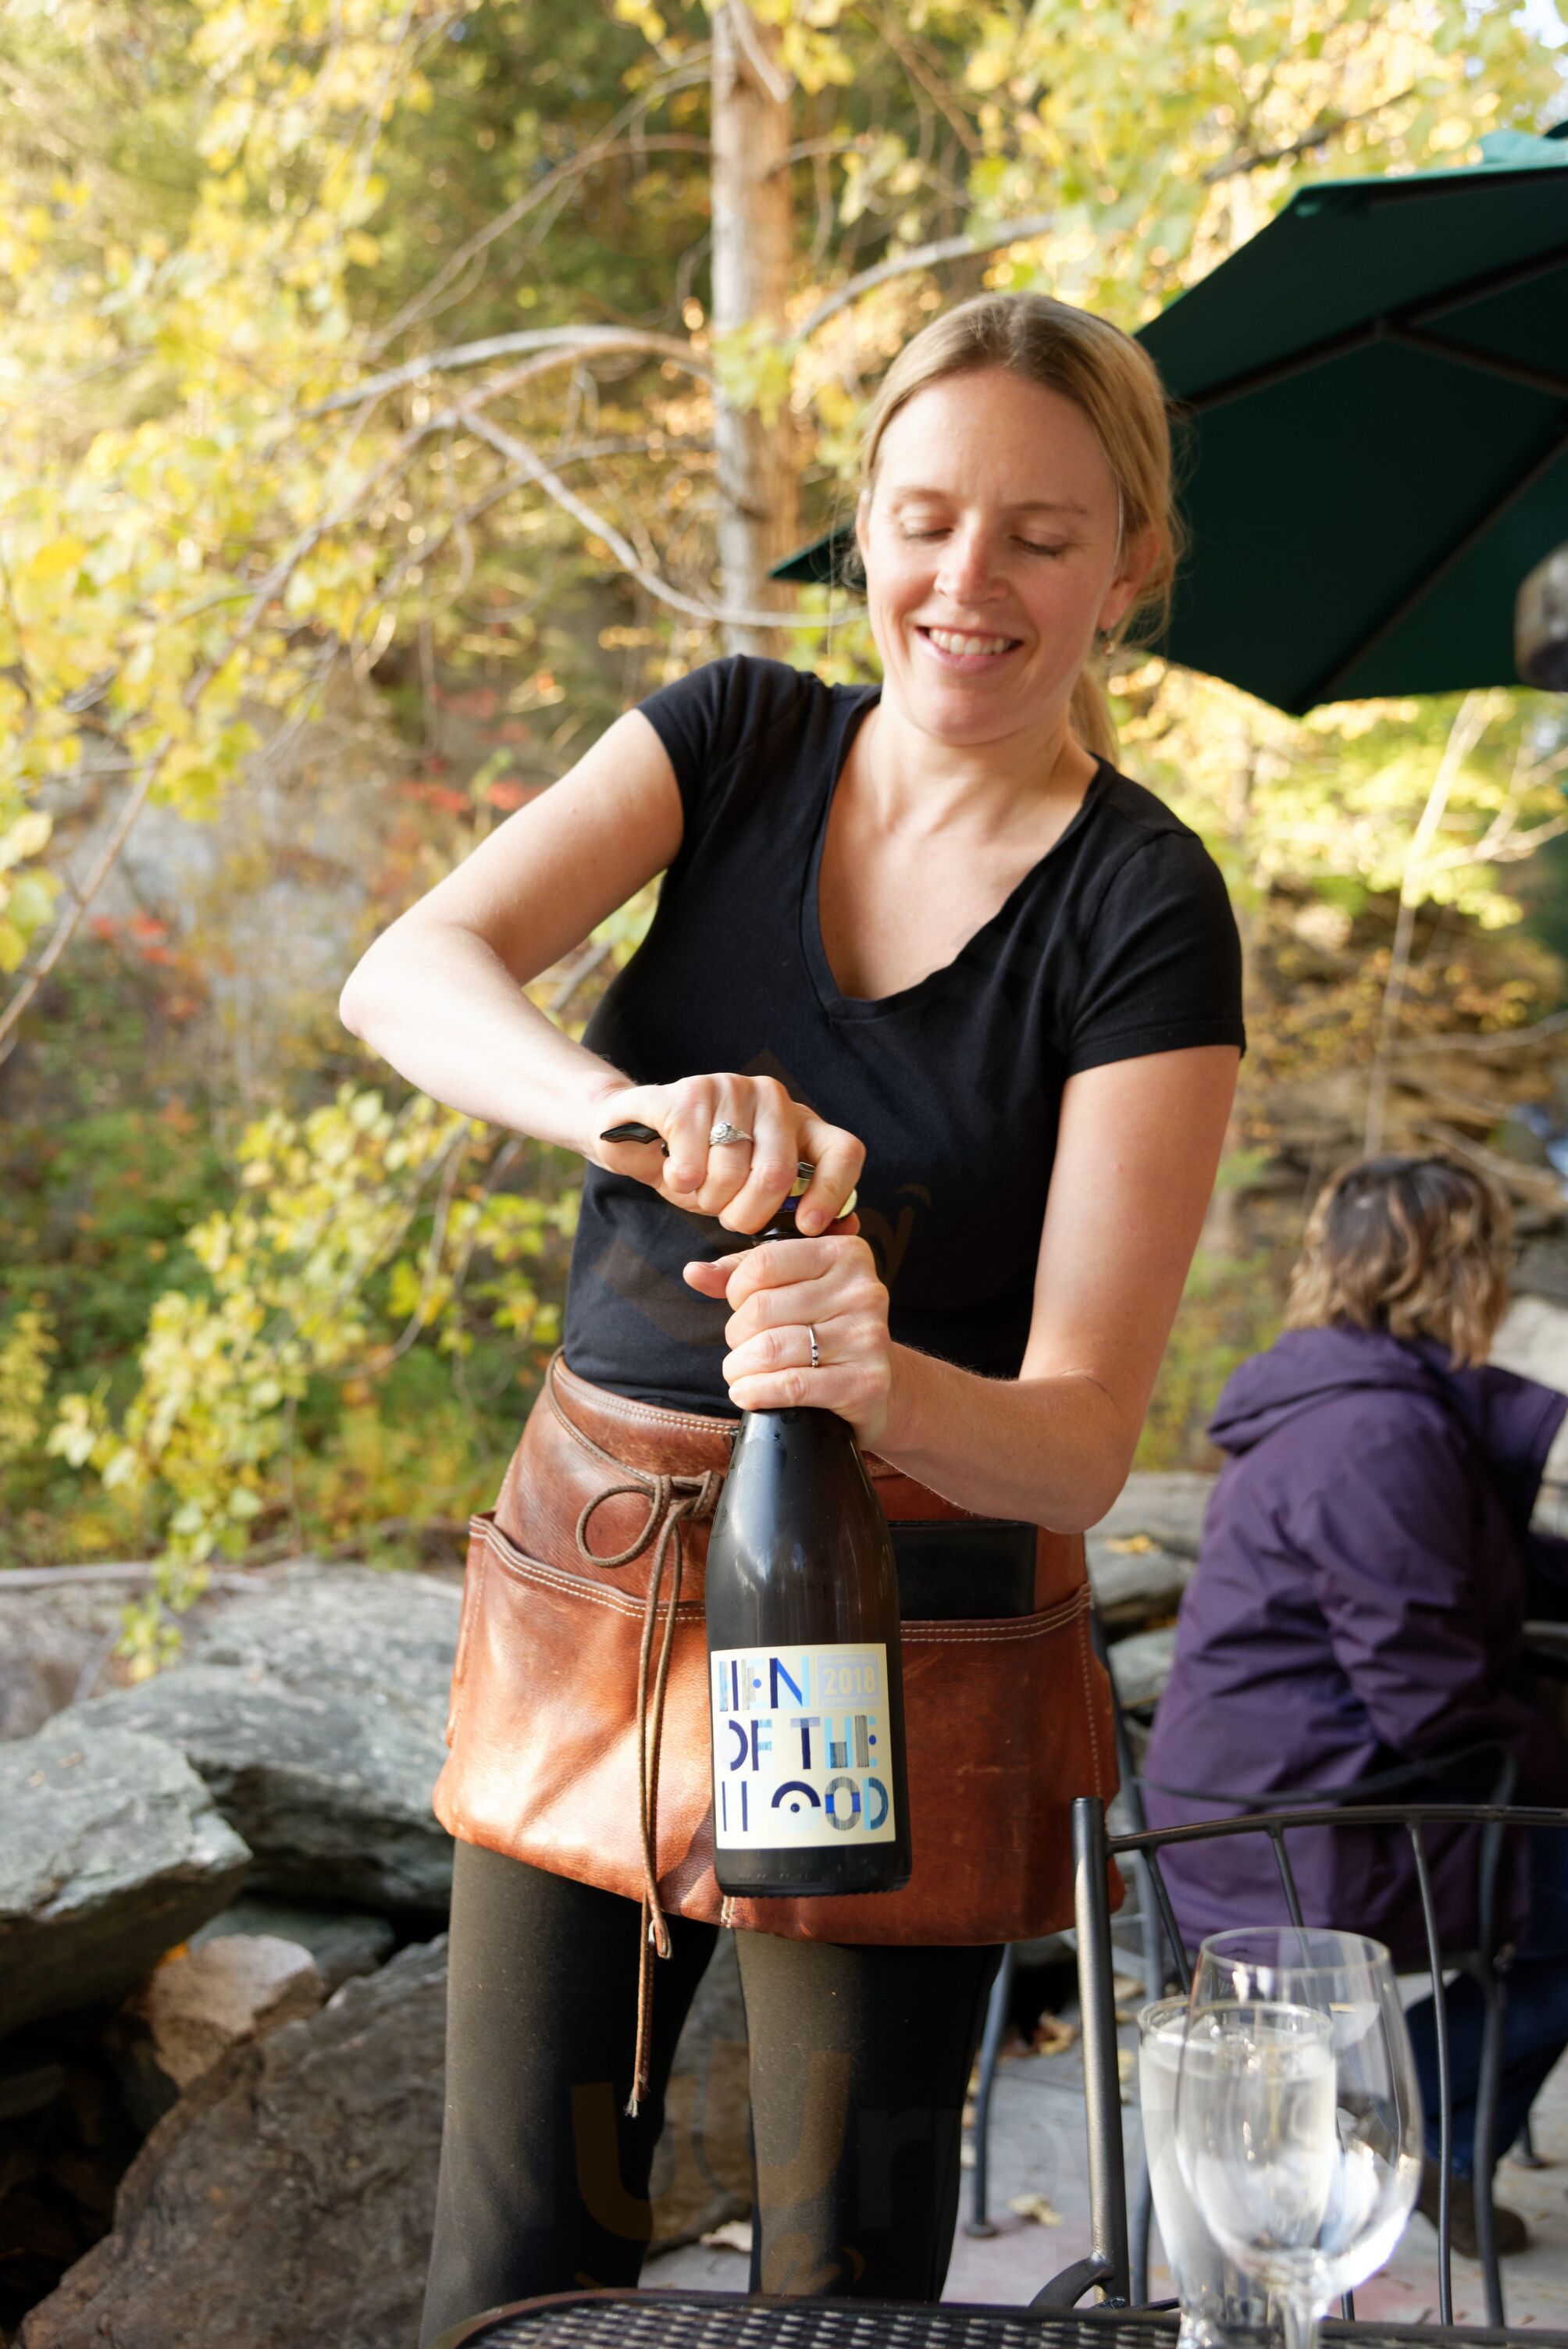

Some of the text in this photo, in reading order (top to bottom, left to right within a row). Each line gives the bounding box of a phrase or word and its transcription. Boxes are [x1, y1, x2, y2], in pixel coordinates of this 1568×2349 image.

[824, 1666, 875, 1695] 2018
[718, 1714, 878, 1771] OF THE
